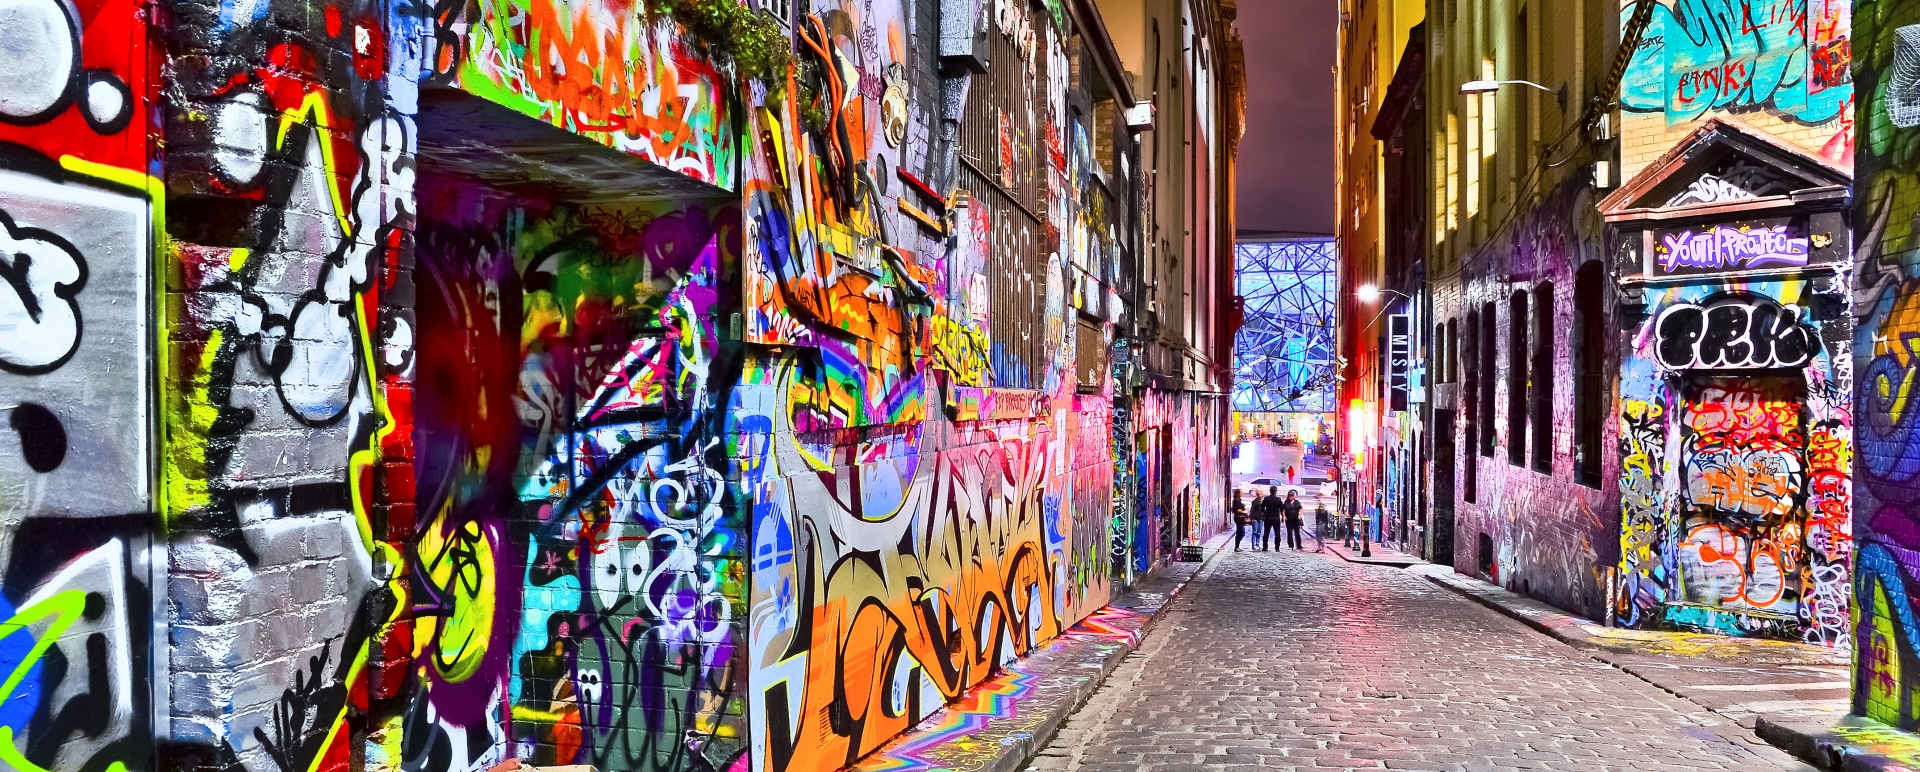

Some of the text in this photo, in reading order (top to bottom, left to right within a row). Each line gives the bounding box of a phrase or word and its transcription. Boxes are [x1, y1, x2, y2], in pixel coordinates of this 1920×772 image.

[1664, 226, 1809, 270] YOUTH PROJECT
[1391, 334, 1408, 392] MISTY
